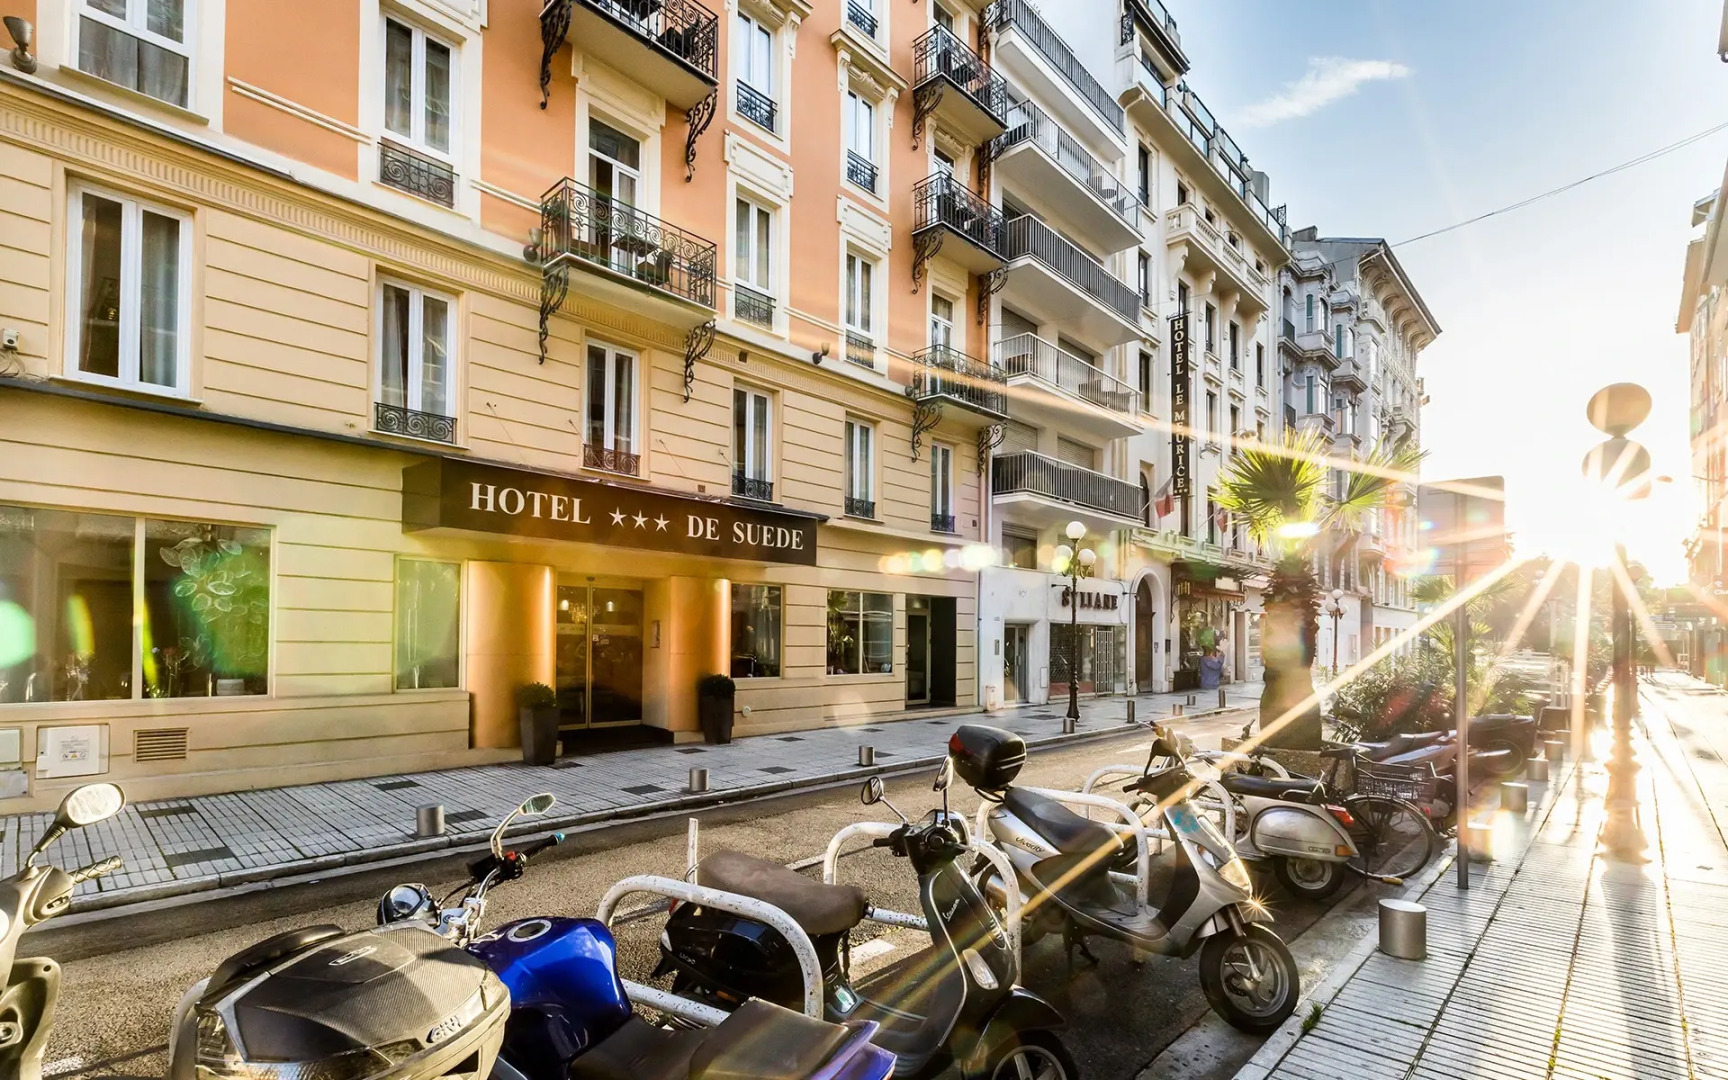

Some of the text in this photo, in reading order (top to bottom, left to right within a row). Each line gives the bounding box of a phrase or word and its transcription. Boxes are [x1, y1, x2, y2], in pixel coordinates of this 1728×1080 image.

[1174, 319, 1185, 488] HOTEL LE MEURICE
[469, 482, 804, 550] HOTEL DE SUEDE
